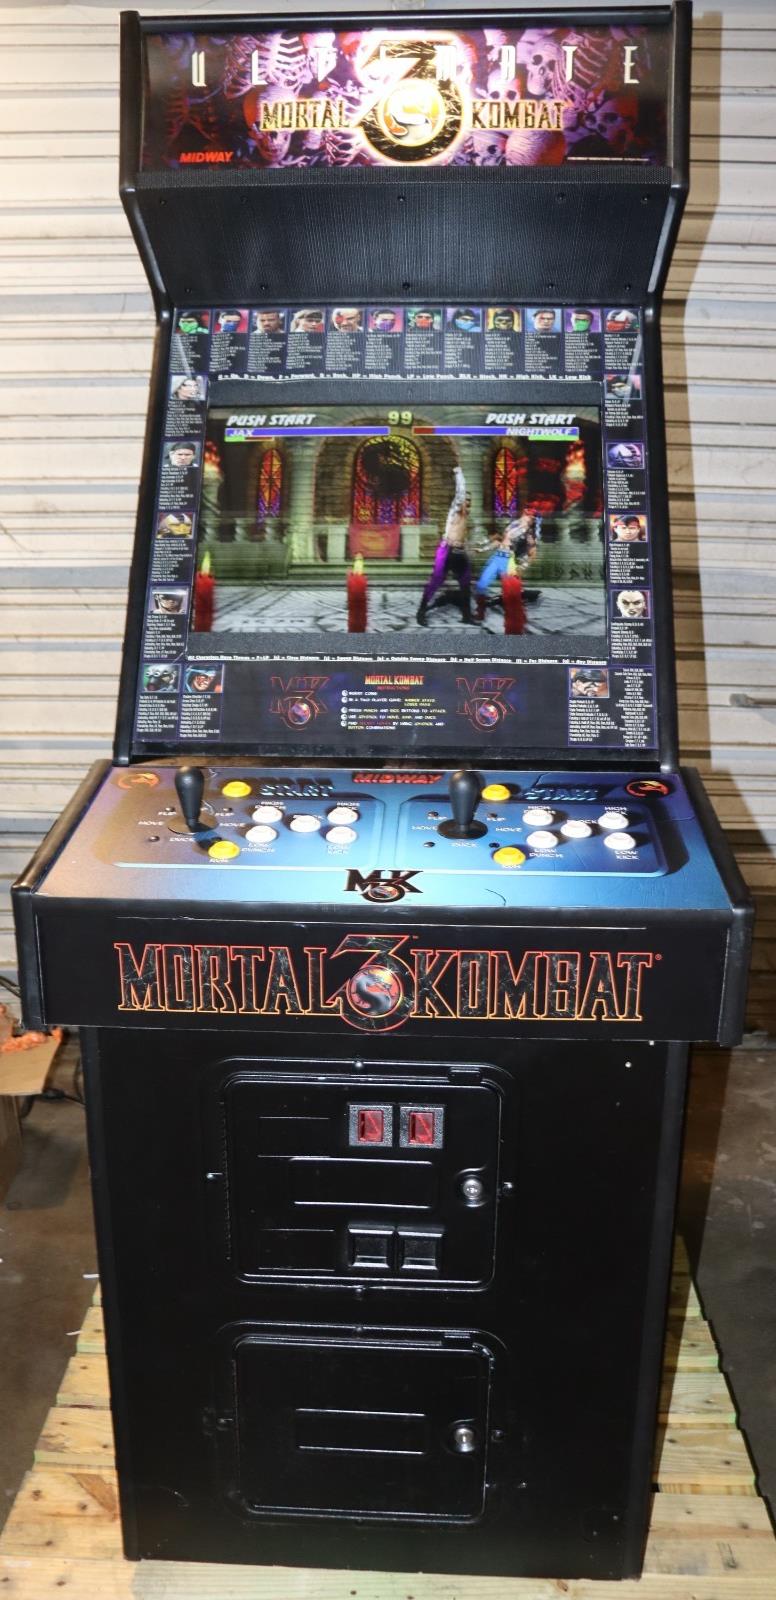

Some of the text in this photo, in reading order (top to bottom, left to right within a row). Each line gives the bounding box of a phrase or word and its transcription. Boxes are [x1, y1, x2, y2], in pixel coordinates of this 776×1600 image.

[260, 99, 350, 131] MORTAL
[470, 99, 565, 131] KOMBAT
[179, 151, 233, 164] MIDWAY
[227, 414, 316, 426] PUSH START
[388, 411, 413, 425] 99
[485, 413, 576, 425] PUSH START
[230, 429, 255, 437] JAX
[505, 427, 573, 436] NIGHTWOLF
[364, 675, 424, 686] MORTAL KOMBAT
[352, 772, 444, 784] MIDWAY
[114, 942, 344, 1016] MORTAL
